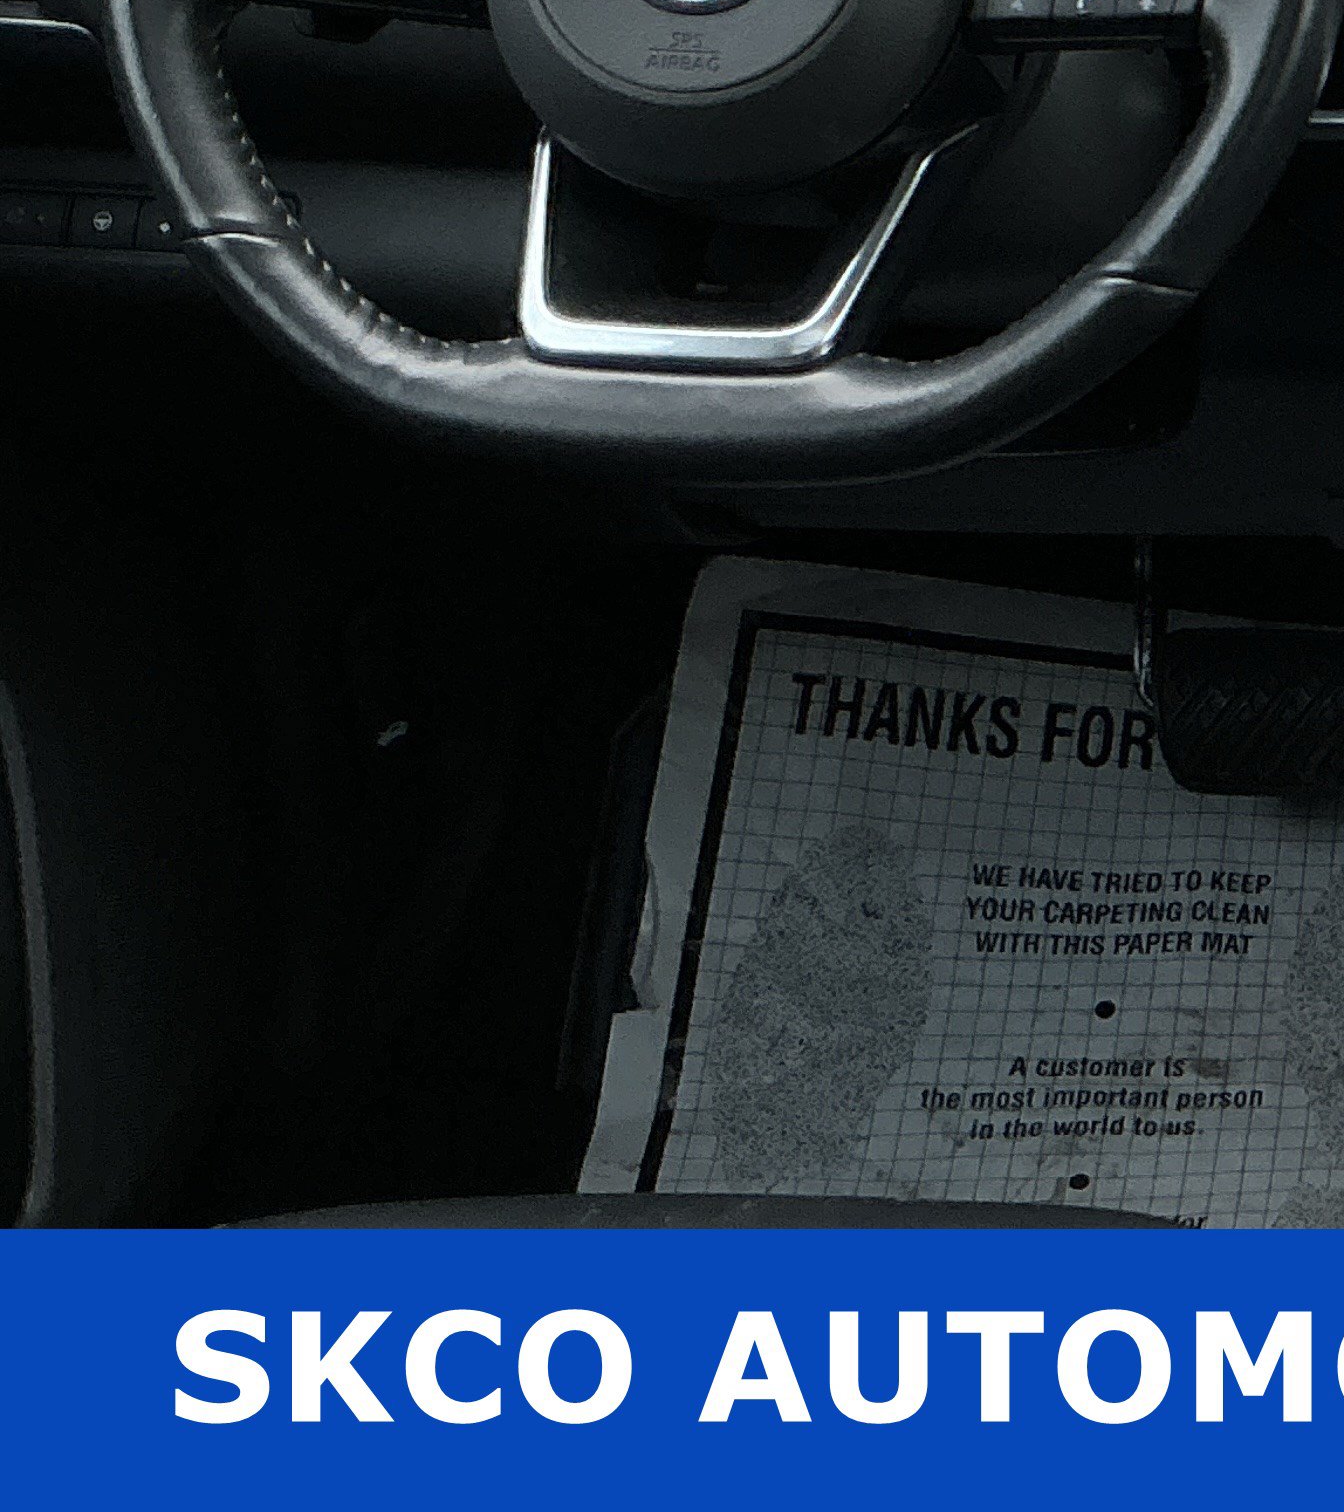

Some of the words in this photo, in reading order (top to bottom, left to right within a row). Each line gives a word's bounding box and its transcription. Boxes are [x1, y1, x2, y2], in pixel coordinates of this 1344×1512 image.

[670, 30, 706, 51] SRS
[643, 53, 721, 73] AIRBAG
[791, 672, 1021, 762] THANKS
[1040, 701, 1157, 771] FOR
[971, 863, 1013, 888] WE
[1018, 866, 1084, 892] HAVE
[1090, 870, 1163, 895] TRIED
[1171, 870, 1203, 892] TO
[1210, 869, 1273, 895] KEEP
[964, 895, 1036, 923] YOUR
[1042, 899, 1183, 925] CARPETING
[1190, 899, 1271, 925] CLEAN
[975, 930, 1043, 955] WITH
[1049, 932, 1106, 956] THIS
[1112, 930, 1194, 956] PAPER
[1200, 931, 1255, 956] MAT
[1008, 1057, 1027, 1077] A
[1034, 1056, 1156, 1078] customer
[1162, 1056, 1188, 1078] is
[920, 1087, 962, 1109] the
[968, 1089, 1037, 1109] most
[1042, 1087, 1170, 1111] important
[1174, 1088, 1265, 1112] person
[969, 1118, 995, 1140] in
[1002, 1118, 1044, 1140] the
[1052, 1114, 1126, 1137] world
[1133, 1115, 1159, 1137] to
[1163, 1119, 1205, 1137] us.
